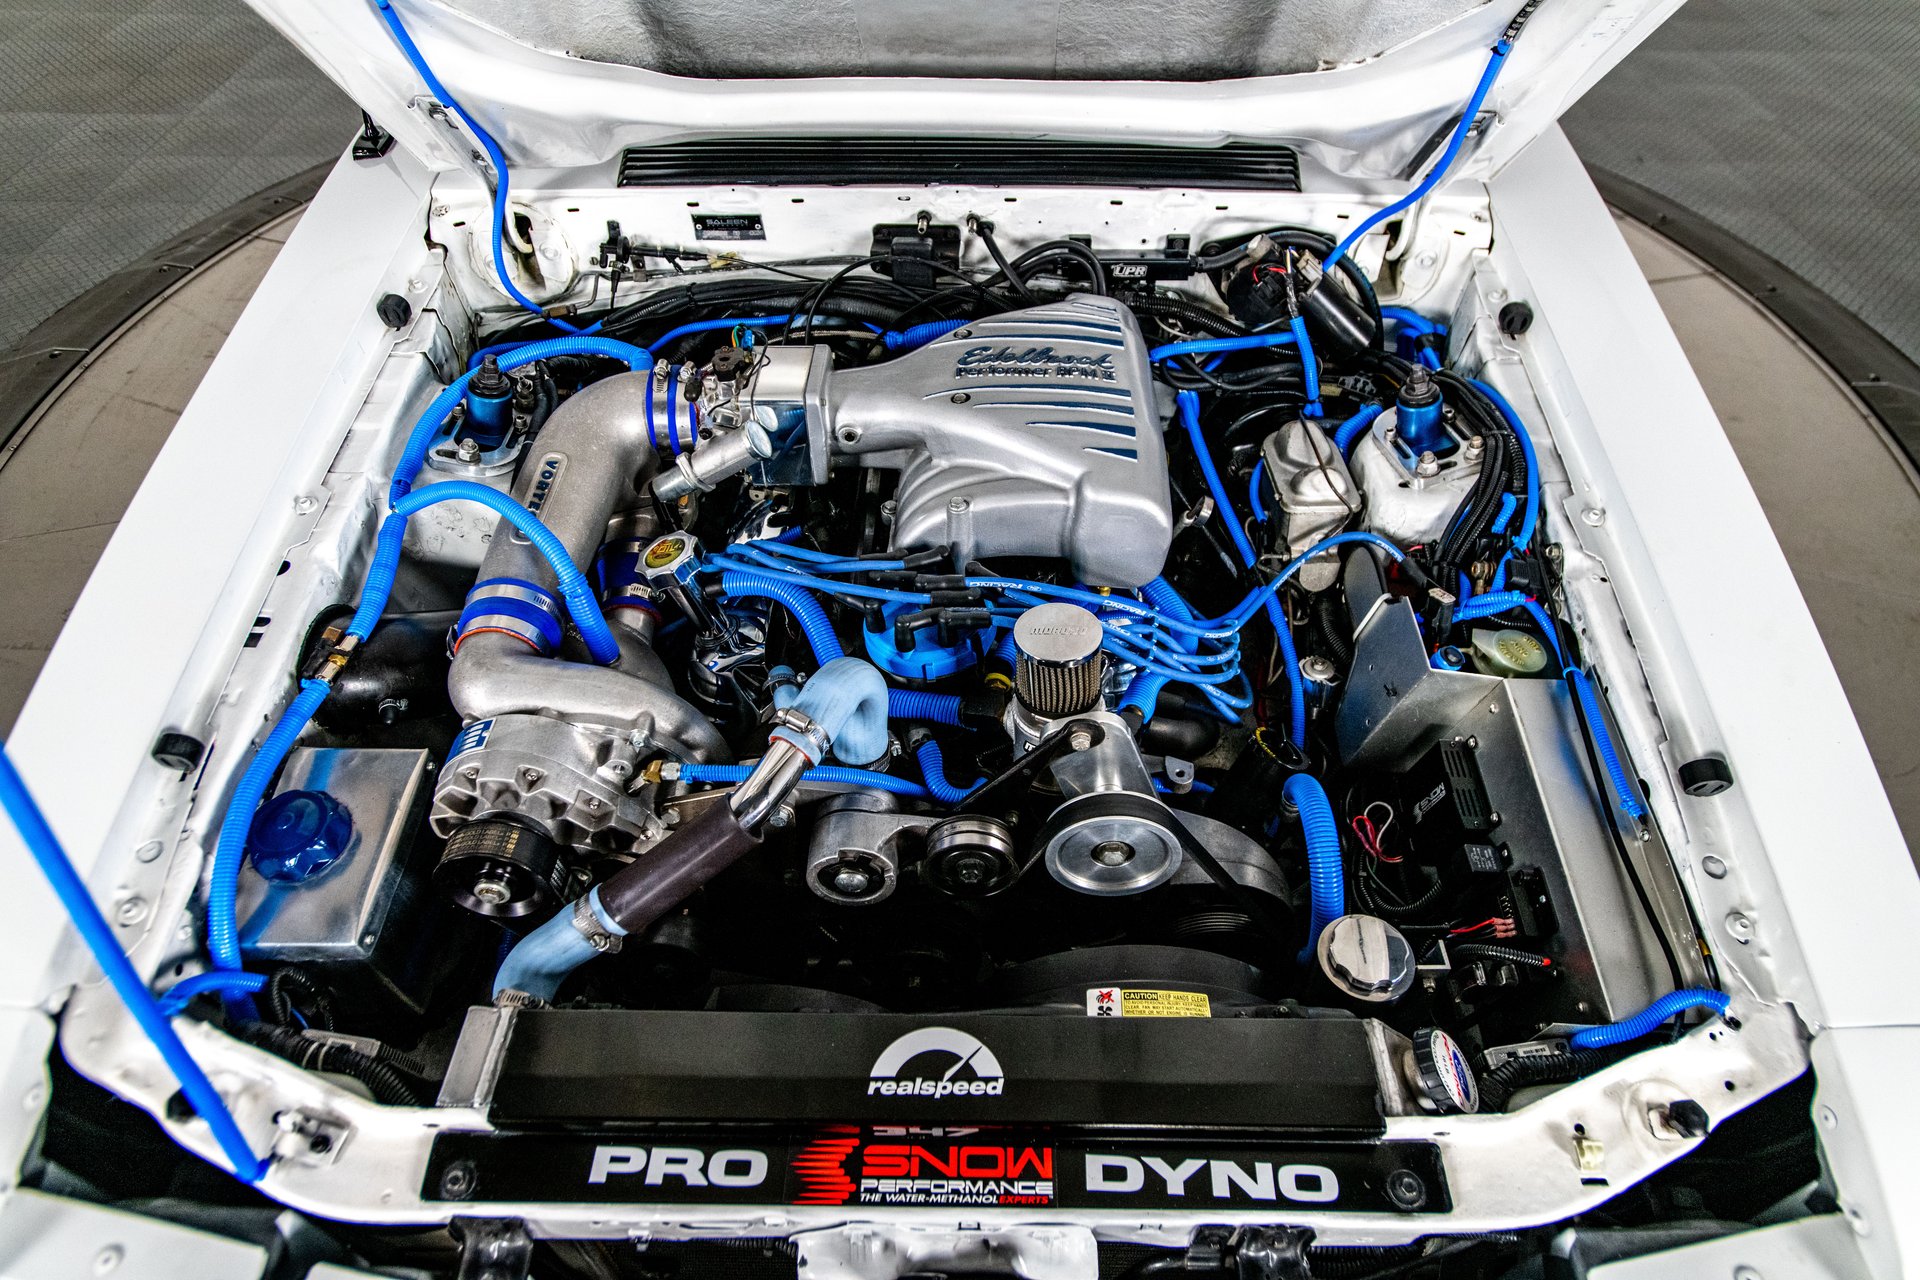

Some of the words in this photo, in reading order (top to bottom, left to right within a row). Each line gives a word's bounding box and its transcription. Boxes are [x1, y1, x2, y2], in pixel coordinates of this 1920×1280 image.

[957, 347, 1116, 370] Edelbrock
[956, 366, 1052, 379] Performer
[1056, 367, 1099, 381] RPM
[867, 1077, 1004, 1099] realspeed
[588, 1145, 769, 1188] PRO
[862, 1145, 1053, 1178] SNOW
[860, 1179, 1053, 1195] PERFORMANCE
[1085, 1153, 1339, 1203] DYNO
[860, 1193, 882, 1202] THE
[999, 1195, 1050, 1205] EXPERTS
